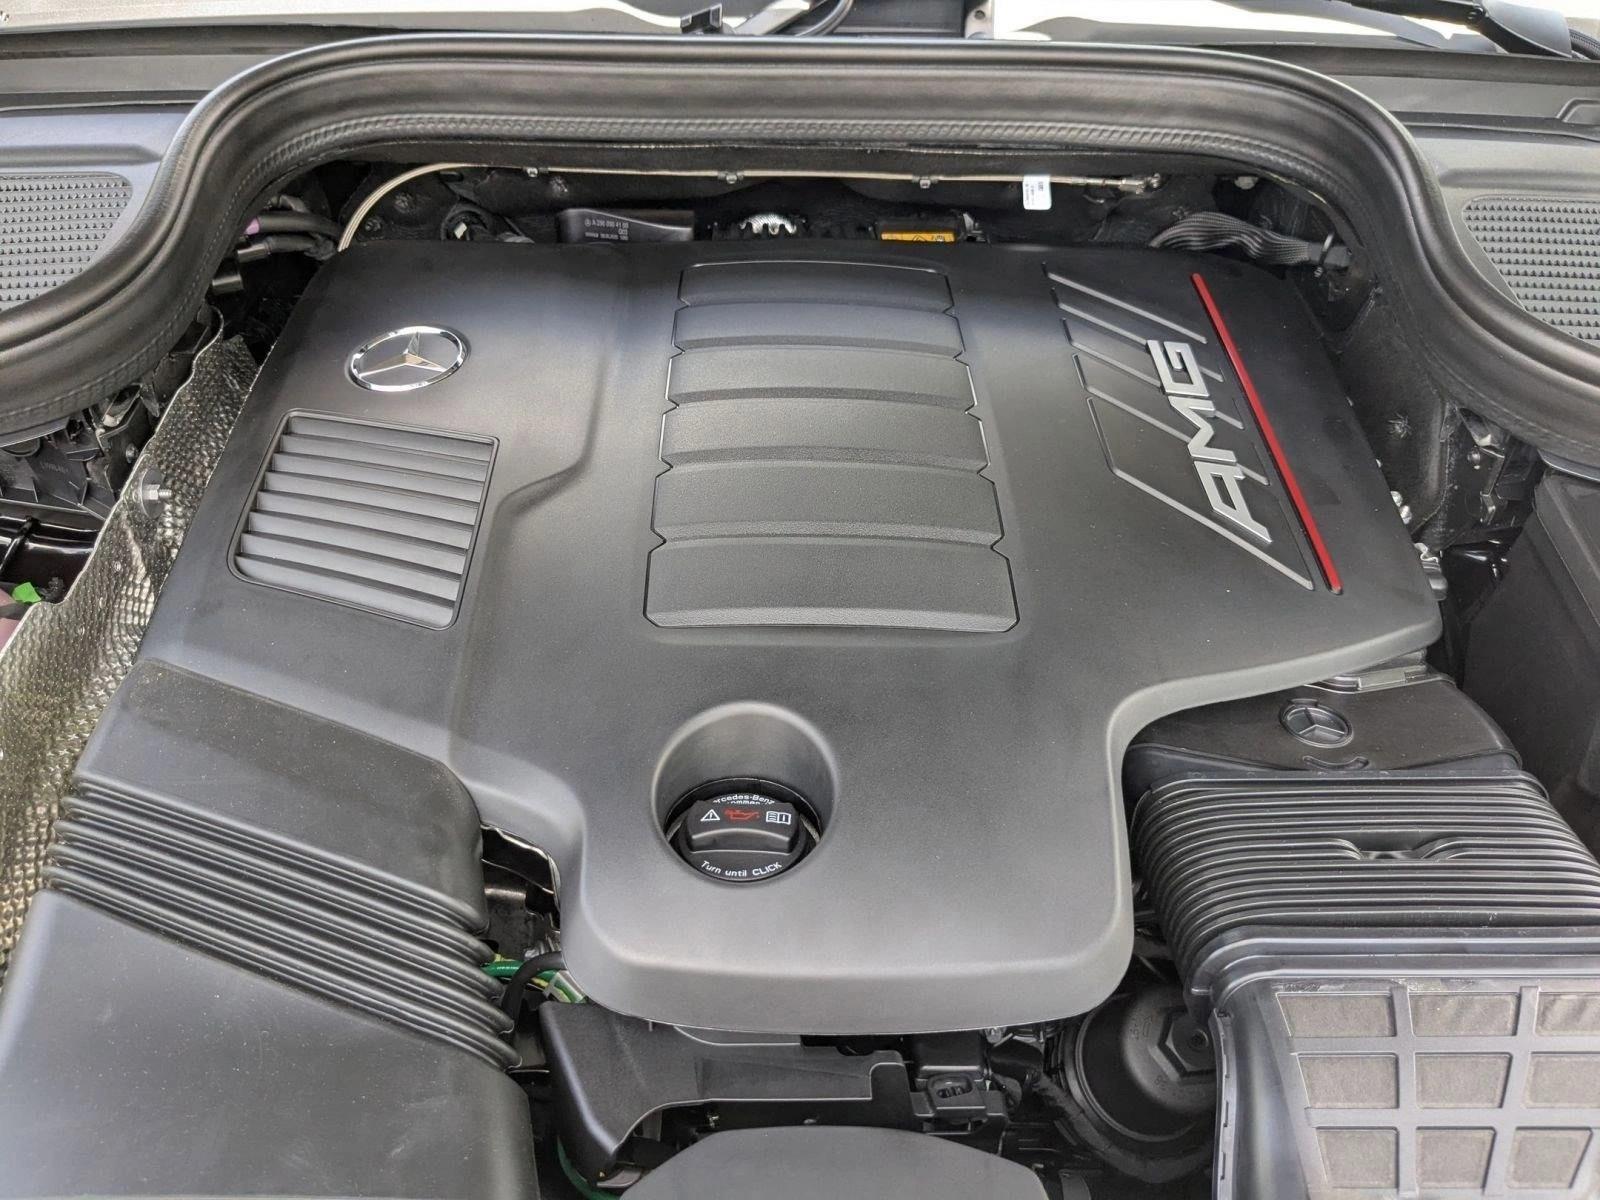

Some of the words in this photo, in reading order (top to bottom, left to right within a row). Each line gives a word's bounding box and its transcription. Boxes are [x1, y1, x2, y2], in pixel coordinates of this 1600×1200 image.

[1146, 339, 1273, 543] AMG
[713, 794, 775, 805] ercedes-Benz
[701, 860, 722, 874] Turn
[725, 868, 747, 877] until
[752, 861, 782, 876] CLICK
